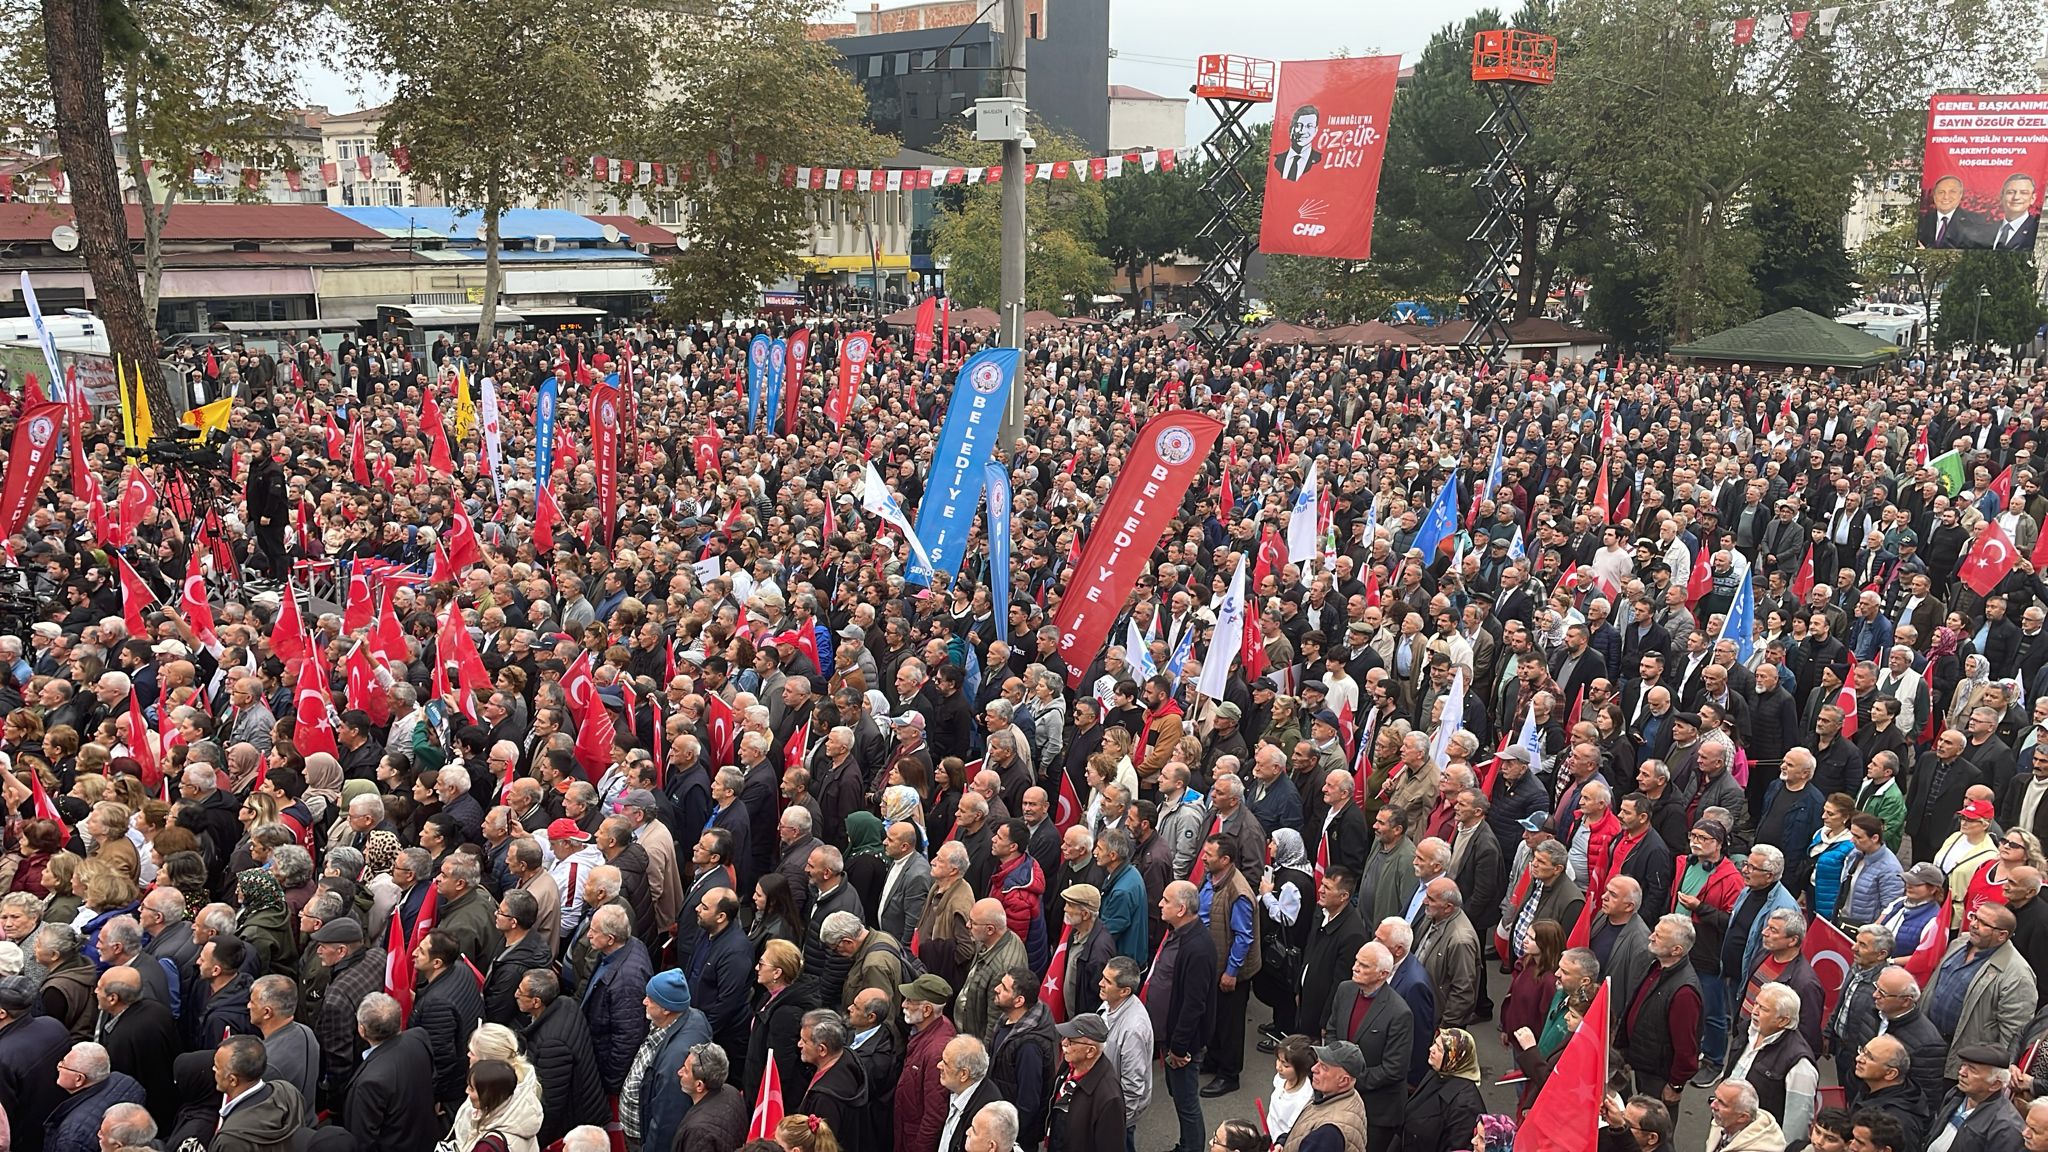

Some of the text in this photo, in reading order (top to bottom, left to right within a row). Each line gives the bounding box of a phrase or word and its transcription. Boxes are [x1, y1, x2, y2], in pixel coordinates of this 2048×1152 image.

[1936, 101, 2048, 112] GENEL BAŞKANIMI
[1328, 114, 1373, 126] İMAMOĞLU'NA
[1939, 117, 2047, 127] SAYIN ÖZGÜR ÖZEL
[1317, 125, 1381, 150] ÖZGÜR-
[1970, 135, 2000, 144] YEŞİLİN
[1949, 147, 2027, 156] BAŞKENTİ ORDU'YA
[1959, 158, 2014, 167] HOŞGELDİNİZ
[1292, 222, 1326, 237] CHP
[931, 395, 987, 563] BELEDİYE İŞ
[1061, 463, 1169, 650] BELEDİYE İŞ
